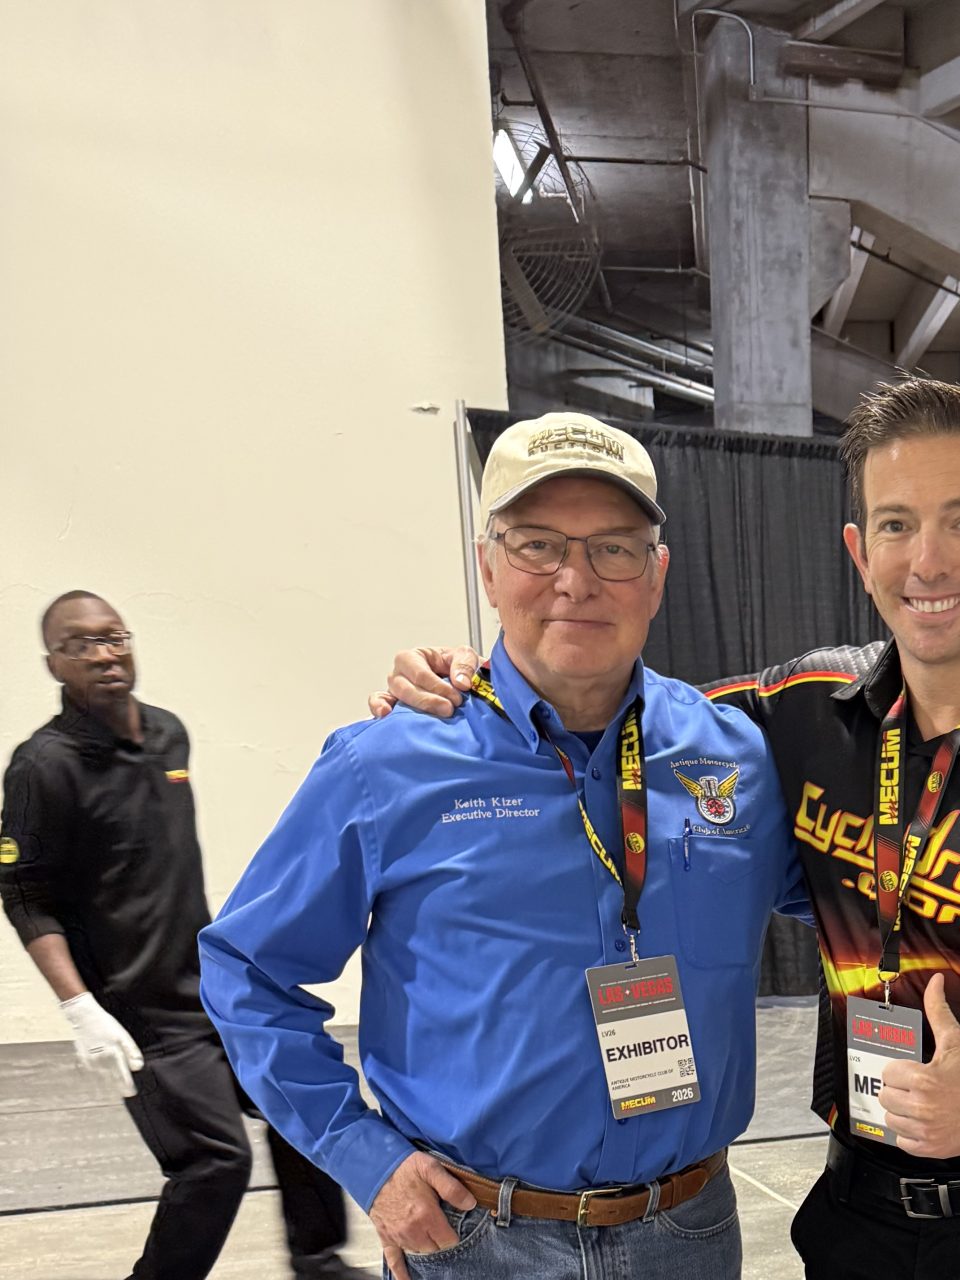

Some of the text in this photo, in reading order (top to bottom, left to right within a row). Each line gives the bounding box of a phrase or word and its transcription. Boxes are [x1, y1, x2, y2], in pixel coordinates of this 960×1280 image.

[879, 727, 901, 826] MECUM
[454, 796, 524, 809] Keith Kizer
[441, 808, 541, 823] Executive Director
[599, 984, 625, 1006] LAS
[631, 977, 674, 1000] VEGAS
[601, 1029, 616, 1038] LV26
[852, 1018, 873, 1040] LAS
[879, 1025, 916, 1047] VEGAS
[606, 1034, 690, 1063] EXHIBITOR
[854, 1073, 882, 1097] ME
[621, 1087, 694, 1111] MECUM 2026
